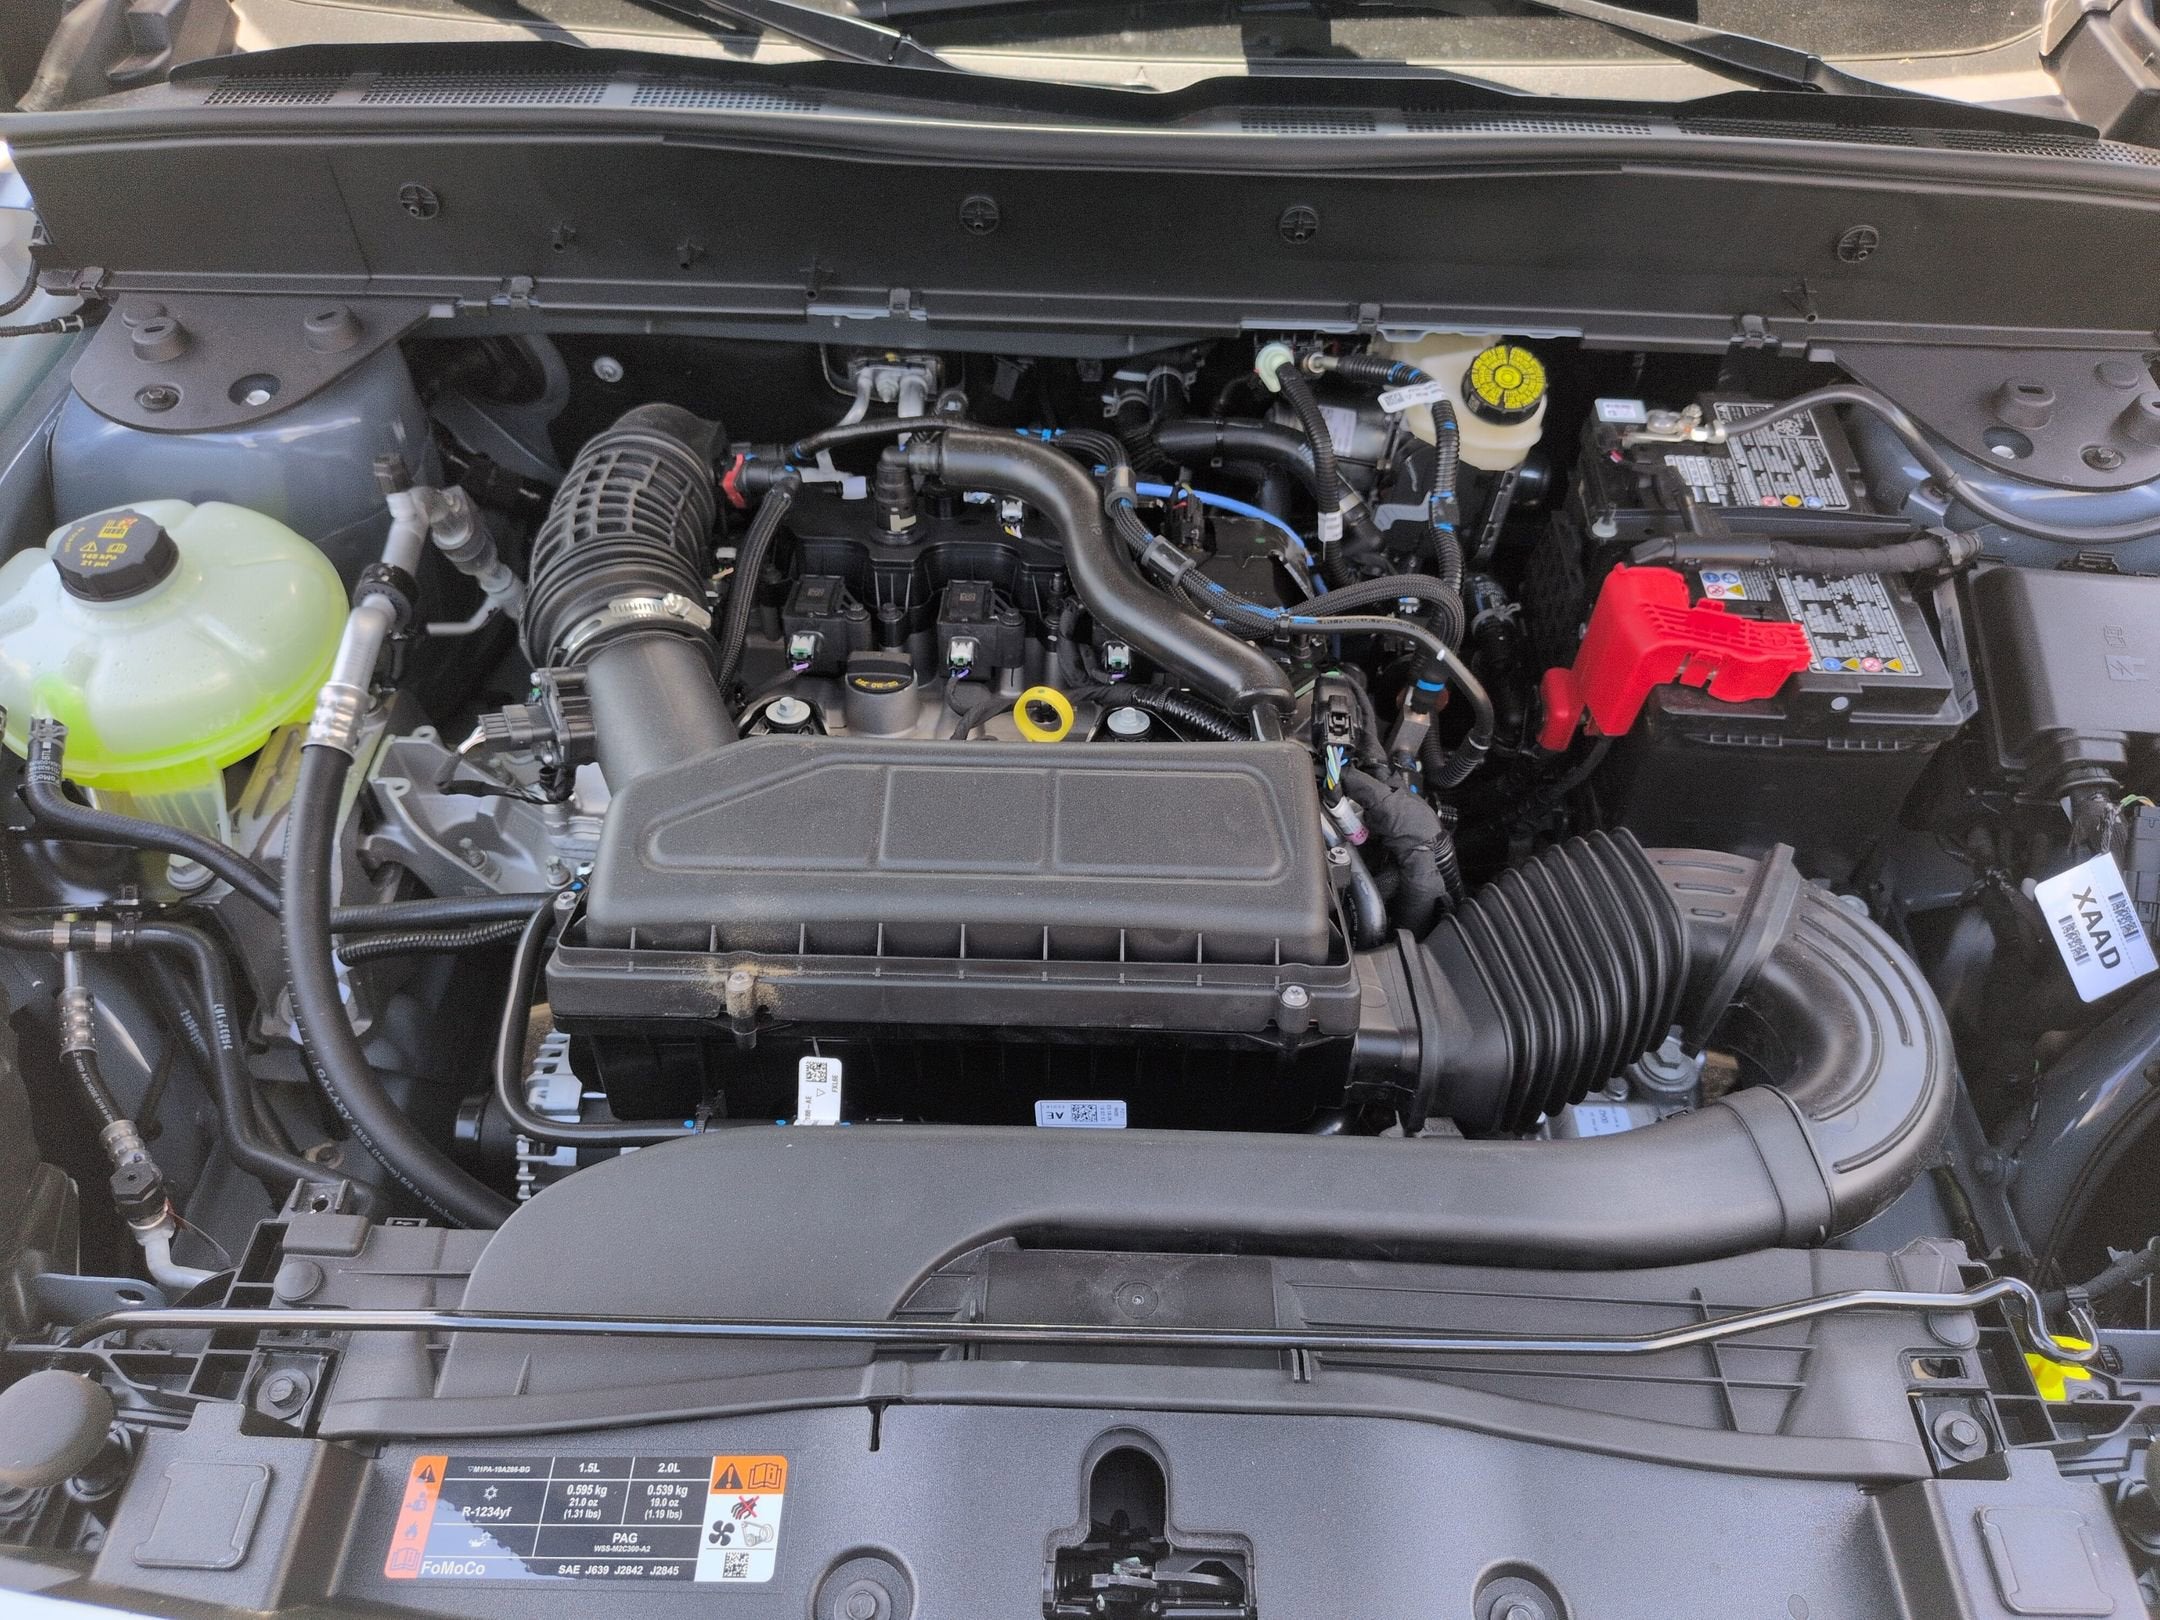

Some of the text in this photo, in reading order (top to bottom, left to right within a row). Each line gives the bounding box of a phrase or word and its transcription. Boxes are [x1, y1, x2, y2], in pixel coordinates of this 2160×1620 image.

[2072, 886, 2121, 970] XAAD
[578, 1462, 601, 1473] 1.5L
[657, 1462, 681, 1473] 2.0L
[566, 1484, 608, 1498] 0.595 kg
[647, 1484, 689, 1498] 0.539 kg
[568, 1497, 599, 1507] 21.0 oz
[650, 1498, 680, 1507] 19.0 oz
[461, 1506, 513, 1520] R-1234yf
[563, 1509, 602, 1520] (1.31 lbs)
[644, 1509, 683, 1521] (1.19 lbs)
[612, 1532, 639, 1544] PAG
[420, 1560, 486, 1575] FoMoCo
[558, 1564, 680, 1576] SAE J639 J2842 J2845
